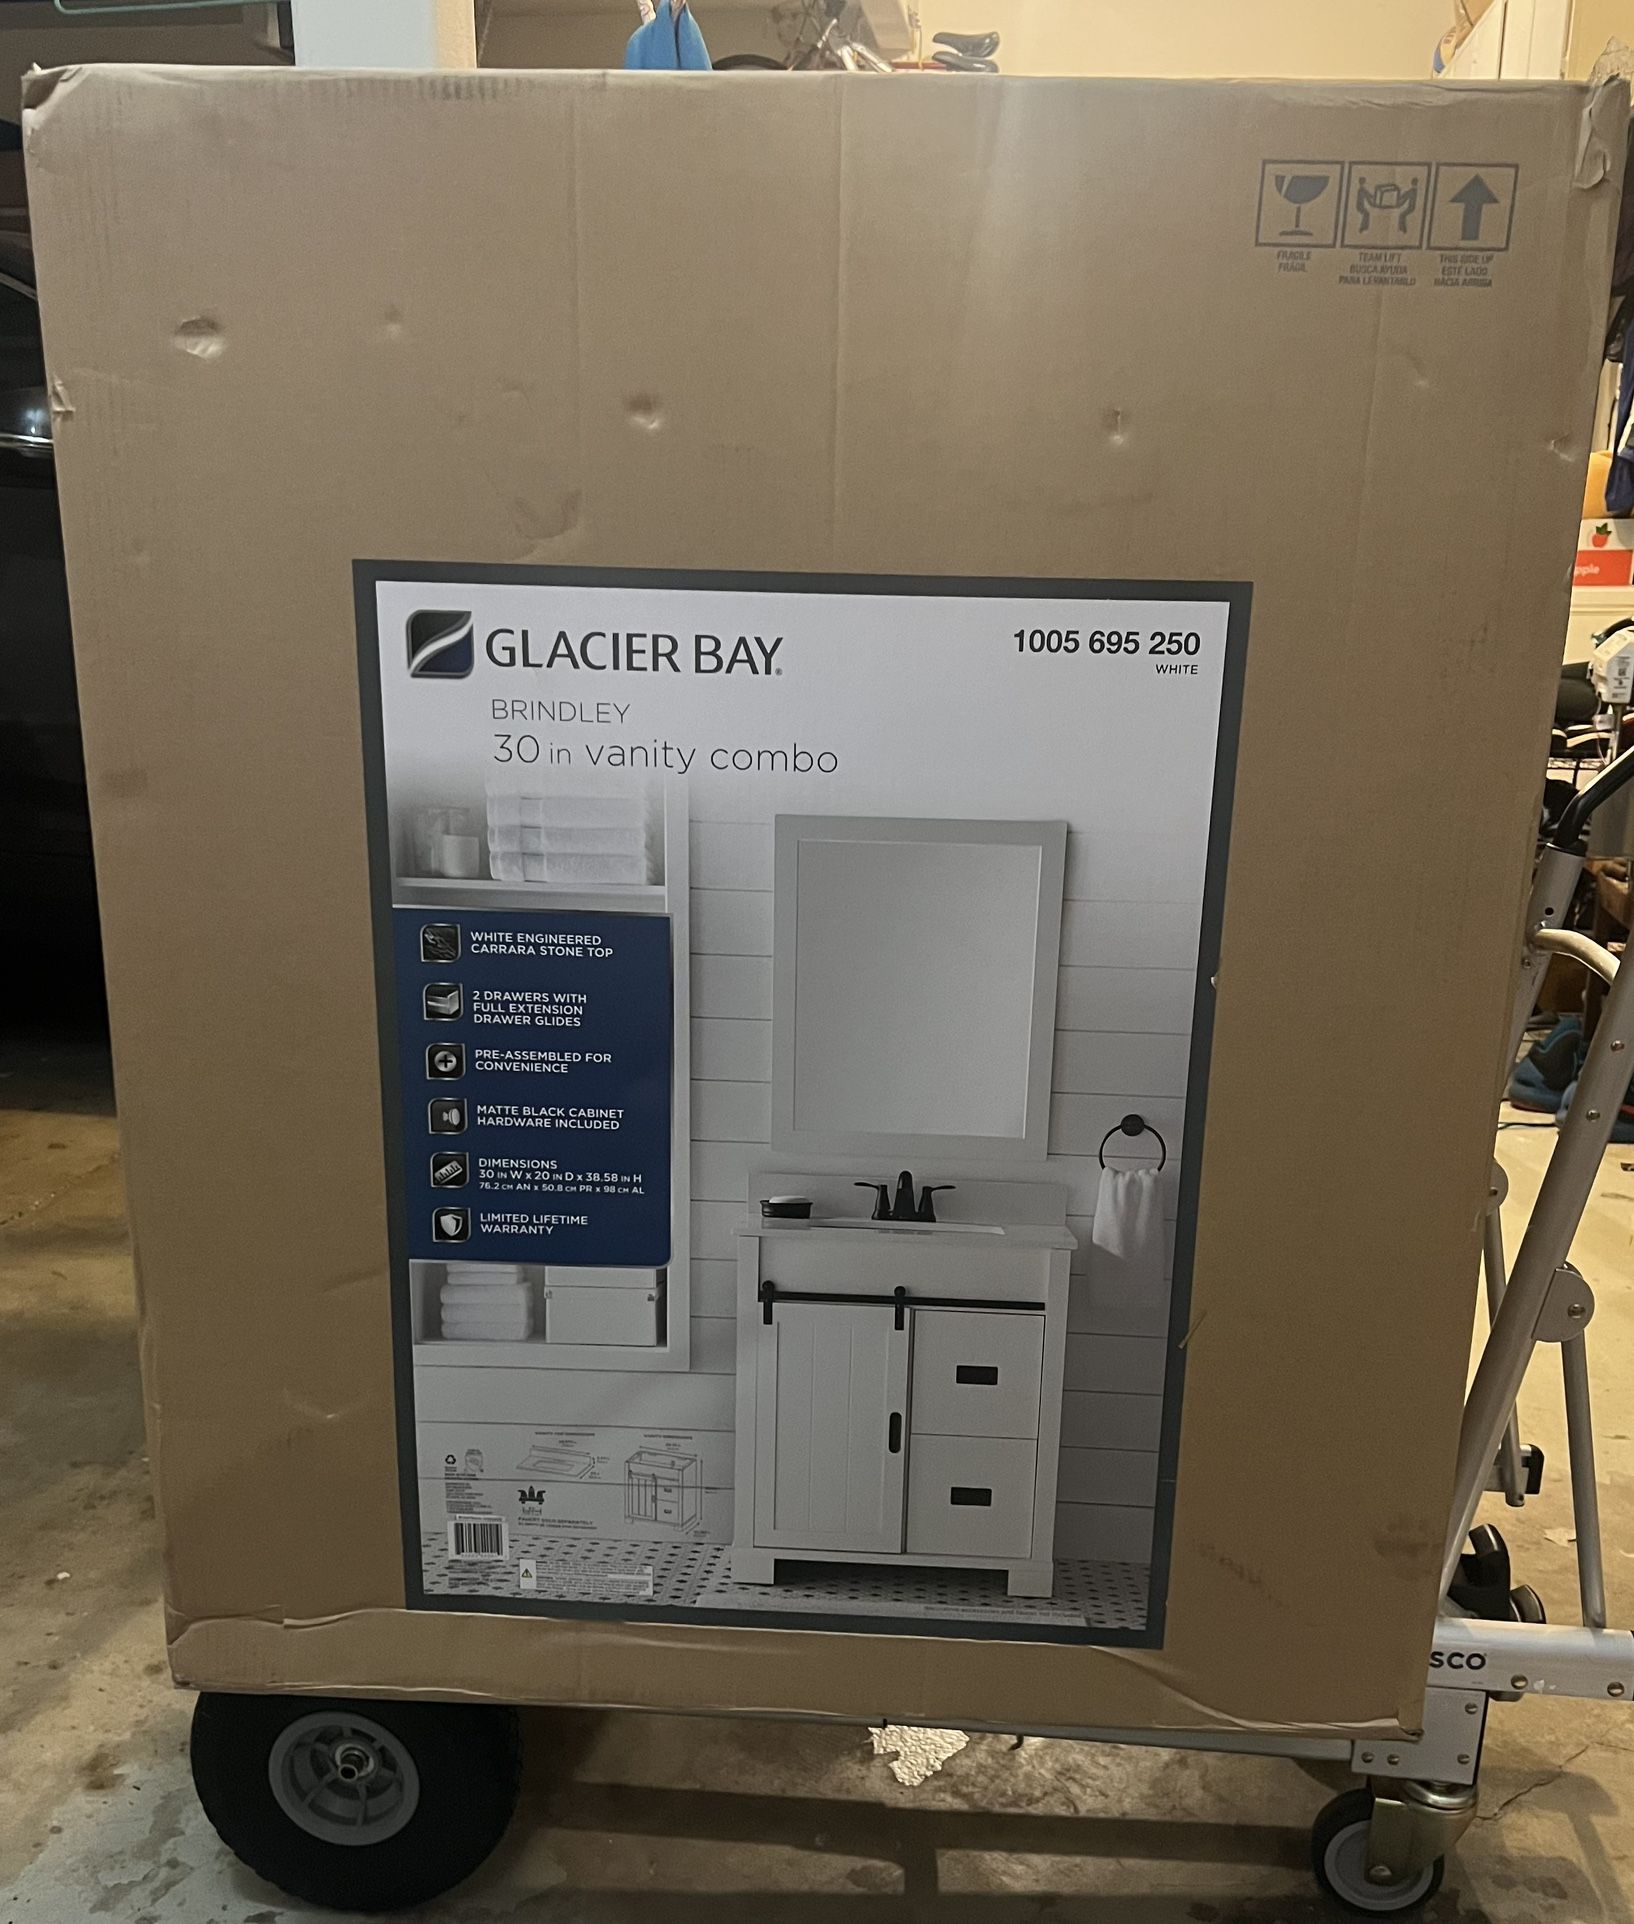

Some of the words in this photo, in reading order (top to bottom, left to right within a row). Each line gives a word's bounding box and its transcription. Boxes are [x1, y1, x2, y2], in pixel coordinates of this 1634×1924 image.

[1277, 250, 1312, 260] FRAGILE
[1359, 252, 1381, 262] TEAM
[1384, 252, 1402, 264] LIFT
[1440, 254, 1457, 263] THIS
[1460, 255, 1479, 264] SIDE
[1482, 255, 1494, 264] UP
[1350, 264, 1377, 274] BUSCA
[1442, 265, 1462, 276] ESTE
[1465, 266, 1488, 276] LADO
[1014, 629, 1080, 653] 1005
[1089, 630, 1140, 654] 695
[1149, 632, 1200, 655] 250
[485, 628, 680, 672] GLACIER
[695, 634, 783, 675] BAY
[1155, 664, 1198, 674] WHITE
[492, 699, 630, 723] BRINDLEY
[493, 734, 539, 763] 30
[550, 743, 571, 765] in
[585, 740, 696, 774] vanity
[710, 743, 838, 773] combo
[471, 932, 512, 943] WHITE
[518, 933, 601, 946] ENGINEERED
[471, 944, 535, 955] CARRARA
[540, 946, 582, 957] STONE
[588, 947, 613, 958] TOP
[473, 991, 479, 1000] 2
[484, 991, 549, 1003] DRAWERS
[553, 993, 586, 1004] WITH
[474, 1003, 505, 1013] FULL
[509, 1004, 583, 1015] EXTENSION
[474, 1014, 531, 1025] DRAWER
[535, 1016, 581, 1026] GLIDES
[475, 1050, 582, 1062] PRE-ASSEMBLED
[585, 1053, 612, 1063] FOR
[475, 1061, 568, 1073] CONVENIENCE
[477, 1105, 518, 1116] MATTE
[523, 1106, 564, 1117] BLACK
[569, 1108, 624, 1119] CABINET
[477, 1116, 551, 1128] HARDWARE
[555, 1118, 620, 1130] INCLUDED
[479, 1158, 558, 1169] DIMENSIONS
[479, 1169, 495, 1179] 30
[497, 1172, 507, 1180] IN
[510, 1170, 524, 1180] W
[534, 1171, 550, 1180] 20
[553, 1173, 563, 1181] IN
[565, 1172, 574, 1181] D
[586, 1172, 618, 1182] 38.58
[634, 1173, 642, 1183] H
[479, 1182, 500, 1190] 76.2
[516, 1182, 531, 1191] AN
[542, 1183, 562, 1192] 50.8
[580, 1184, 593, 1192] PR
[603, 1185, 616, 1193] 98
[631, 1186, 644, 1194] AL
[480, 1213, 529, 1223] LIMITED
[533, 1214, 588, 1225] LIFETIME
[480, 1224, 554, 1235] WARRANTY
[1429, 1651, 1486, 1670] SCO
